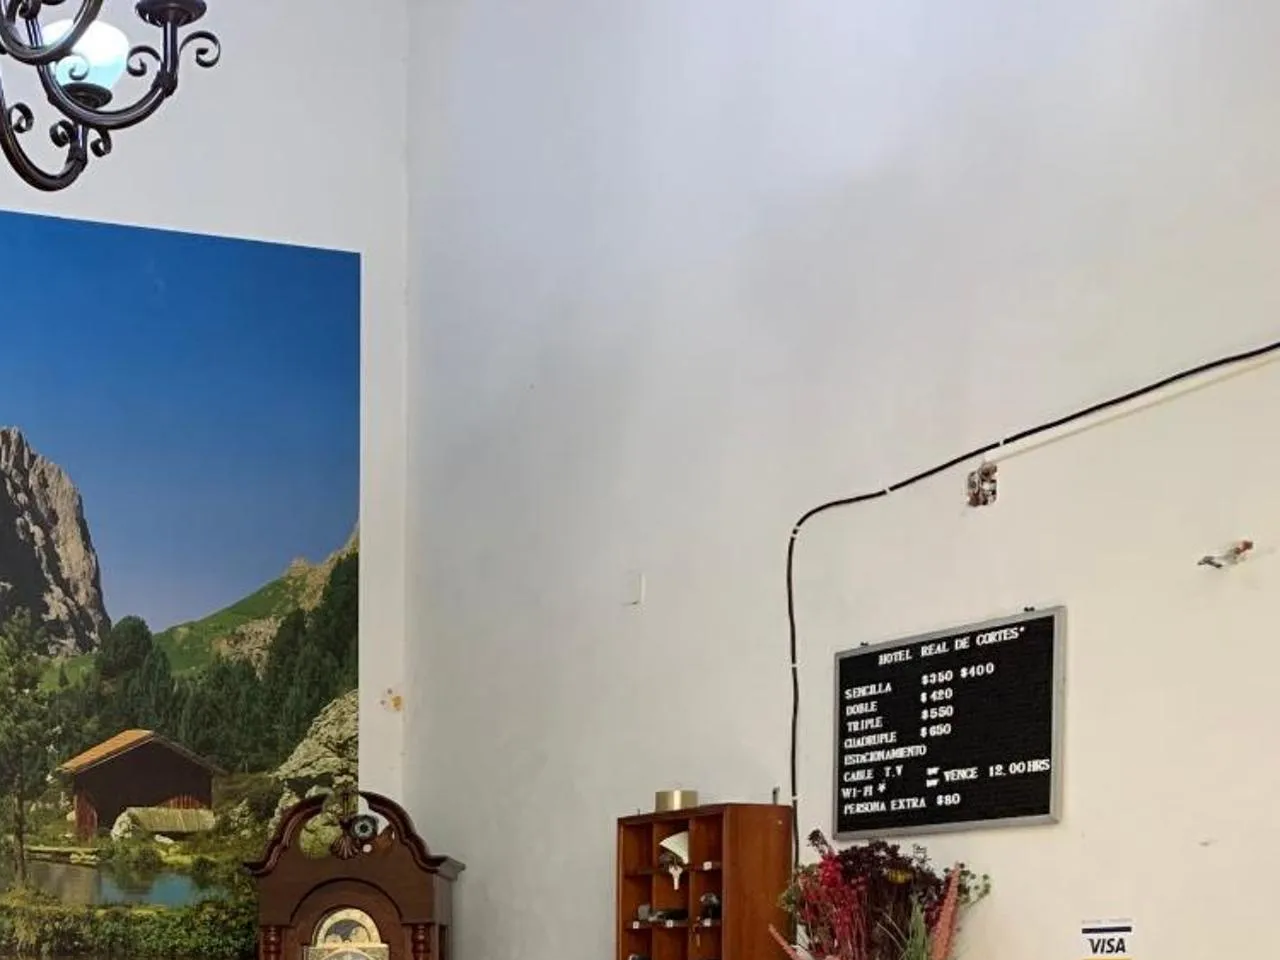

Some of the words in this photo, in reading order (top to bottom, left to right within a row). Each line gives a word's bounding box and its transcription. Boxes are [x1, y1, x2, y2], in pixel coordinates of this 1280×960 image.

[878, 650, 912, 665] HOTEL
[921, 642, 949, 657] REAL
[954, 637, 970, 649] DE
[844, 682, 892, 699] SENCILLA
[921, 670, 953, 685] $350
[960, 662, 995, 678] $400
[846, 701, 878, 716] DOBLE
[847, 716, 883, 732] TRIPLE
[921, 705, 953, 720] $550
[844, 731, 897, 748] CUADRUPLE
[843, 769, 874, 782] CABLE
[943, 767, 978, 781] VENCE
[844, 801, 886, 815] PERSONA
[890, 797, 927, 811] EXTRA
[936, 793, 961, 805] $80
[1088, 938, 1126, 954] VISA
